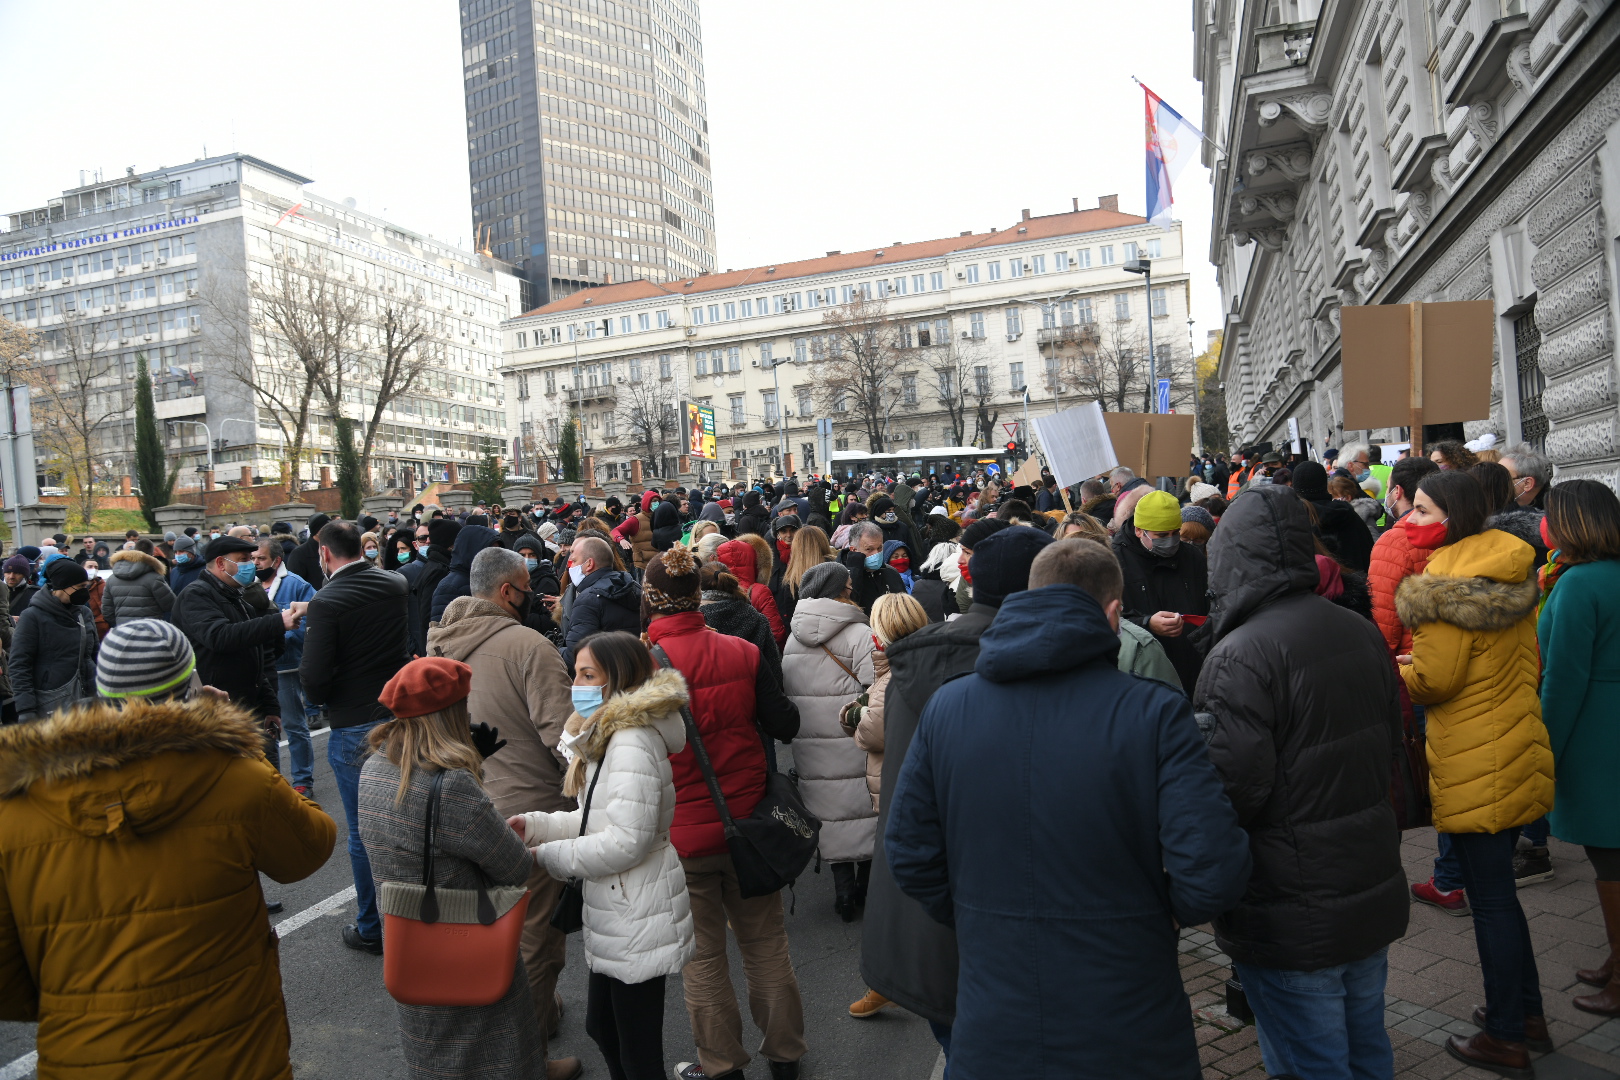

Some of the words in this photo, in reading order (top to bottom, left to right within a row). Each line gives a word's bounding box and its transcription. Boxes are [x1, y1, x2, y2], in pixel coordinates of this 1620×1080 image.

[1, 244, 57, 261] БЕОГРАДСКИ
[62, 234, 108, 250] ВОДОВОД
[123, 215, 200, 237] КАНАЛИЗАЦИЈА
[694, 736, 710, 766] Invicta
[453, 927, 470, 938] bag
